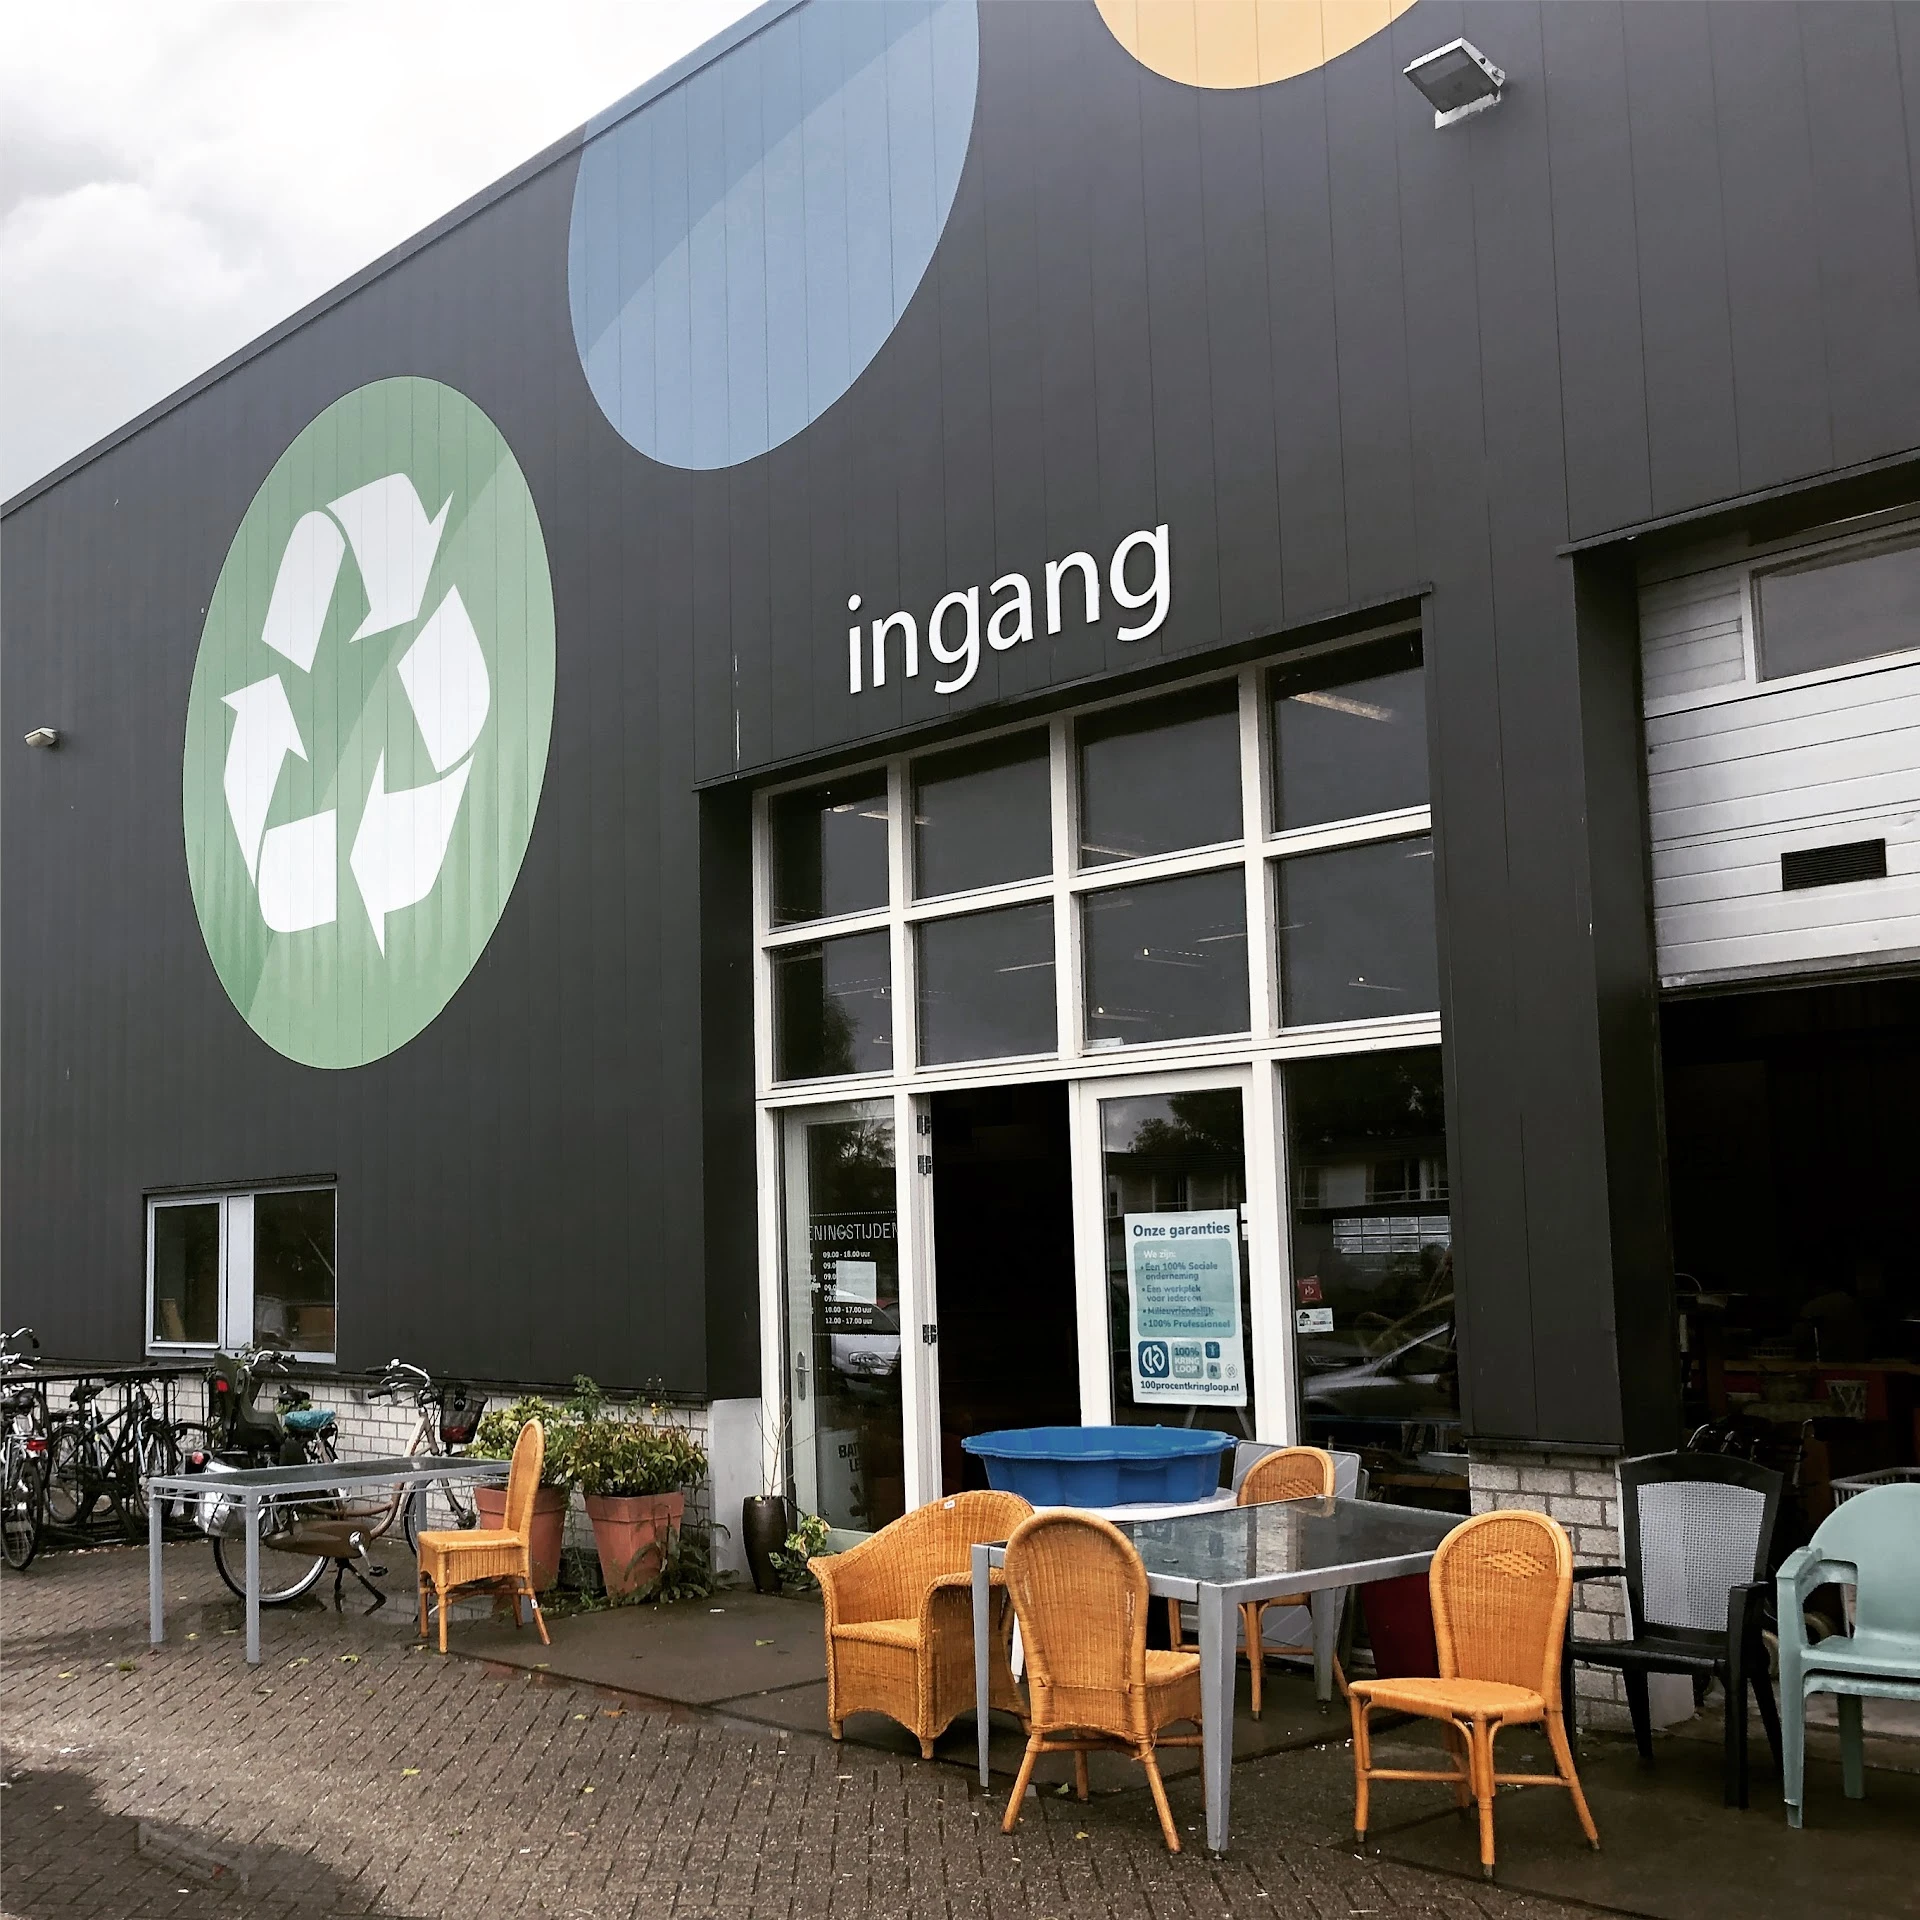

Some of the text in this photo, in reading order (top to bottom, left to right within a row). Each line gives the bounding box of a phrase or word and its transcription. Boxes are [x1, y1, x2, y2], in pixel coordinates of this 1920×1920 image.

[847, 523, 1172, 695] ingang
[1133, 1221, 1231, 1238] Onze garanties
[822, 1251, 840, 1259] 09.00
[843, 1250, 860, 1258] 18.00
[1143, 1249, 1177, 1260] We zijn:
[1162, 1262, 1186, 1271] 100%
[1188, 1261, 1218, 1270] Sociale
[1145, 1273, 1199, 1281] onderneming
[1146, 1284, 1201, 1294] Een werkplek
[1167, 1294, 1202, 1302] iedereen
[824, 1306, 841, 1314] 10.00
[845, 1306, 862, 1314] 17.00
[1147, 1306, 1214, 1316] Milieuvriendelijk
[845, 1317, 862, 1325] 17.00
[1148, 1319, 1231, 1328] 100% Professioneel
[1174, 1347, 1200, 1356] 100%
[1174, 1357, 1200, 1365] KRING
[1175, 1365, 1200, 1373] LOOP!
[1140, 1380, 1239, 1393] 100procentkringloop.nl
